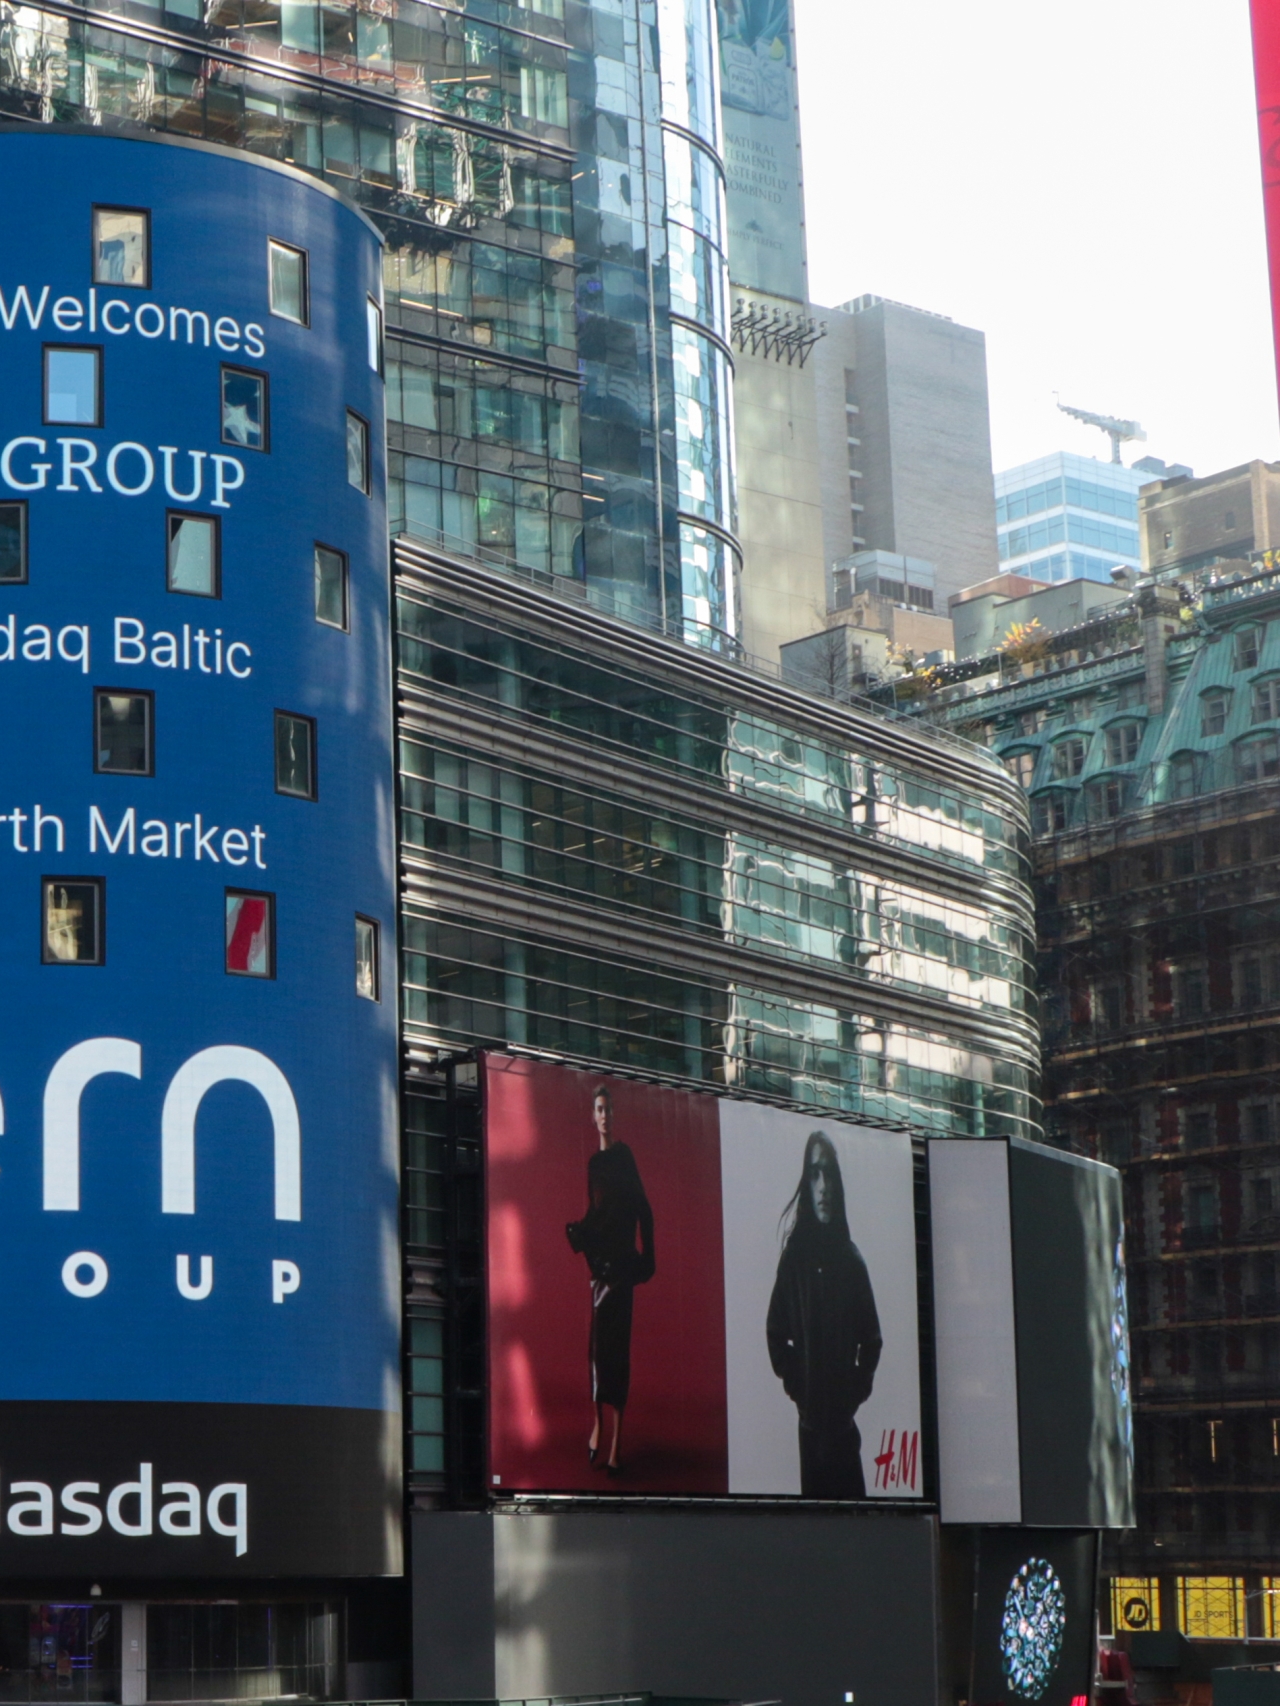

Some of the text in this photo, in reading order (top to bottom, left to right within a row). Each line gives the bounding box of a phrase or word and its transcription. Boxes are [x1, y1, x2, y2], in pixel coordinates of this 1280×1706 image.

[724, 132, 777, 158] NATURAL
[726, 164, 789, 191] ASTERFULLY
[0, 436, 246, 508] GROUP
[114, 616, 252, 678] Baltic
[89, 805, 267, 870] Market
[873, 1428, 919, 1492] H&M
[1126, 1603, 1147, 1622] JD
[1193, 1610, 1233, 1619] JD SPORTS
